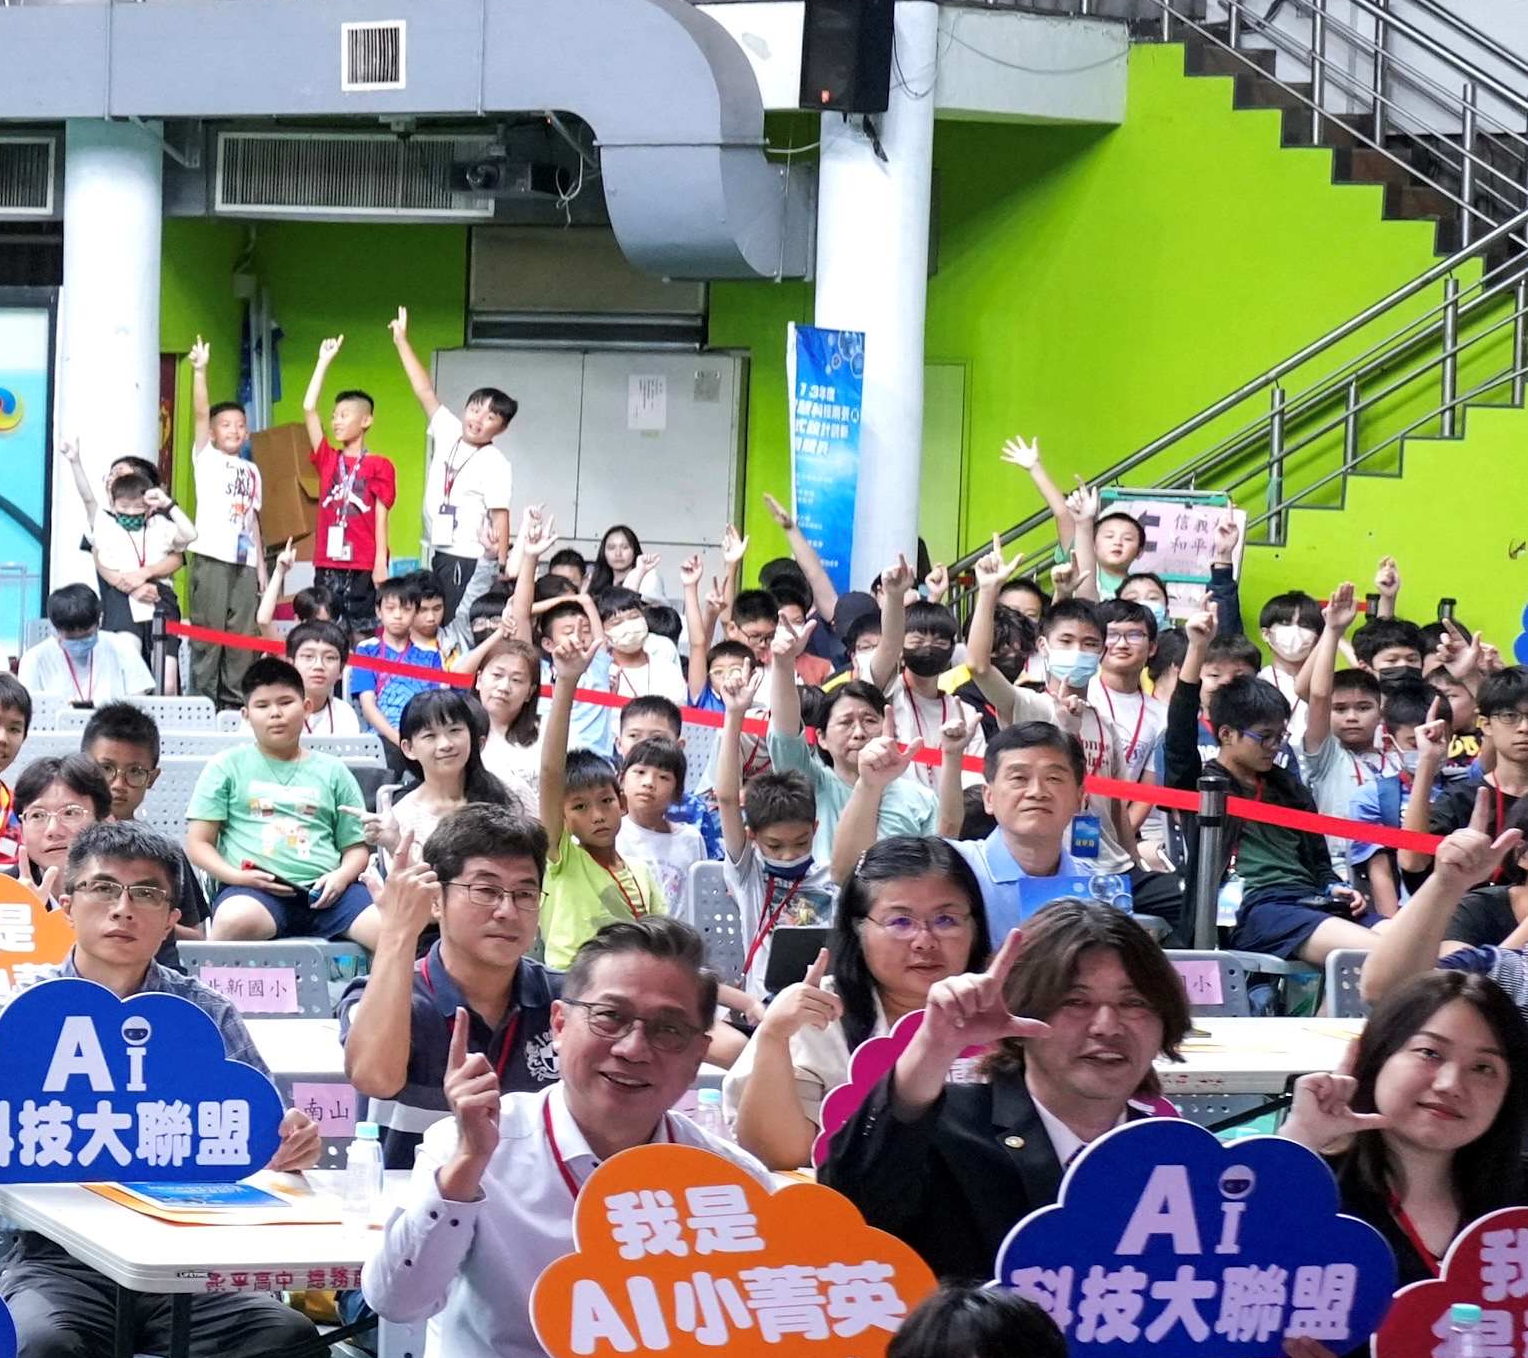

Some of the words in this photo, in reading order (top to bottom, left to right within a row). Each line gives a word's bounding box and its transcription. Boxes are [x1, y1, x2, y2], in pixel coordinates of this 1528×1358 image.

[1175, 514, 1220, 534] 信義
[606, 1184, 765, 1262] 我是
[568, 1261, 911, 1356] AI小菁英
